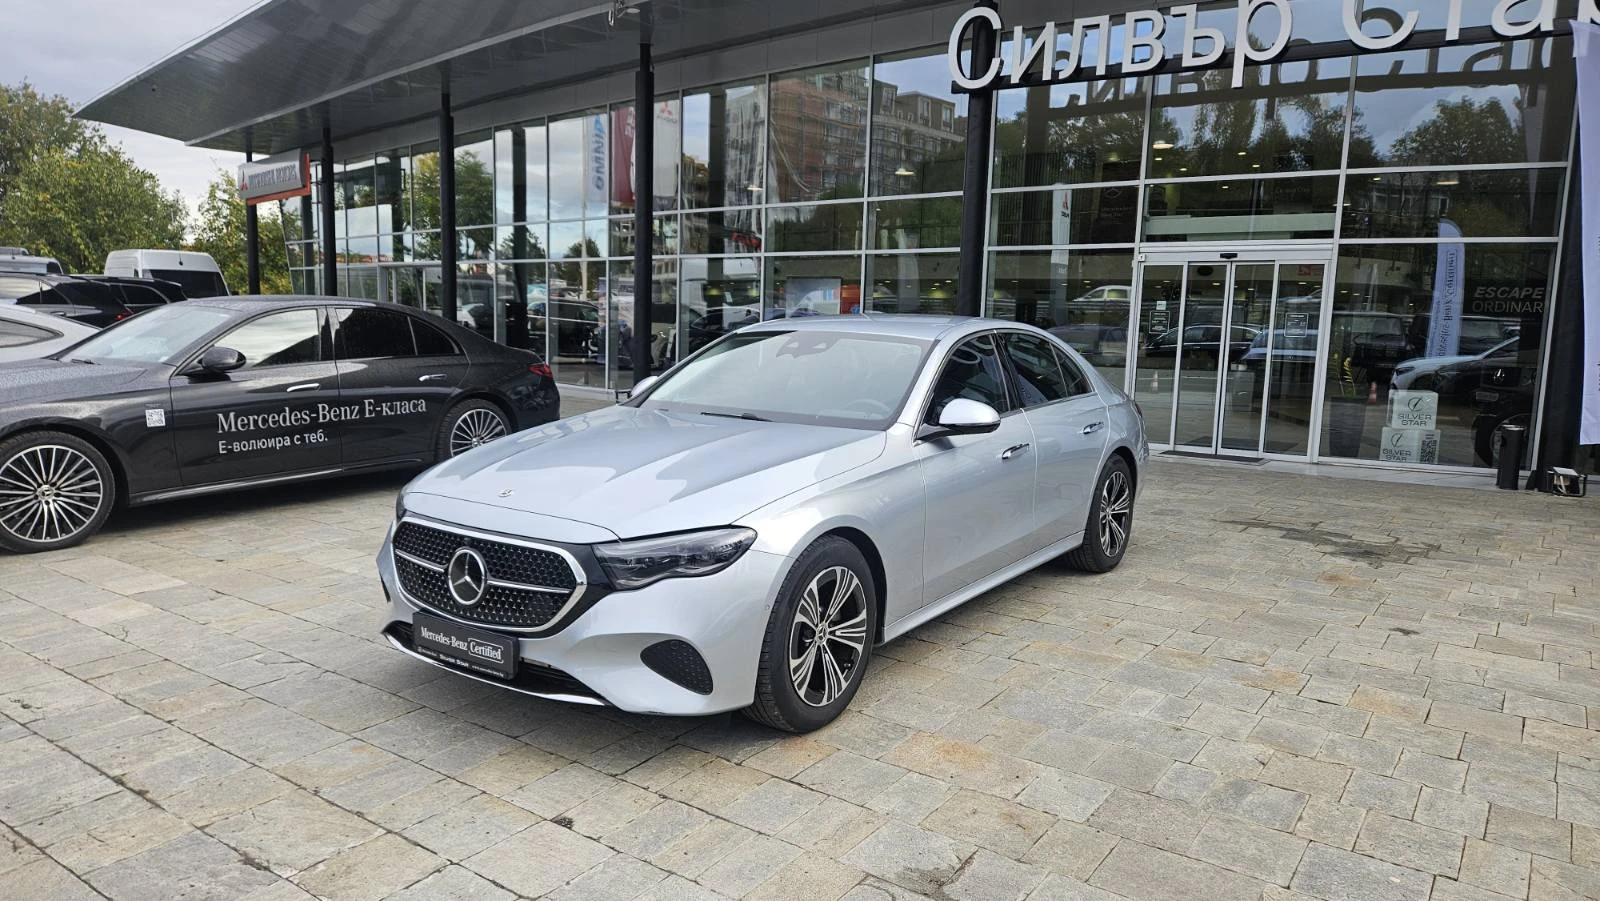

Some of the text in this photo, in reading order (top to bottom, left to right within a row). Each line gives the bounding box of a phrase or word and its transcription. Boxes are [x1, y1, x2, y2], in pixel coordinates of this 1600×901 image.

[948, 0, 1293, 90] Силвър
[1472, 286, 1544, 299] ESCAPE
[1471, 300, 1544, 313] ORDINAR
[217, 398, 427, 433] Mercedes-Benz Е-класа
[218, 434, 291, 454] Е-волюира
[304, 428, 328, 443] теб.
[1382, 448, 1411, 456] SILVER
[420, 625, 502, 660] Mercedes-Benz Certified
